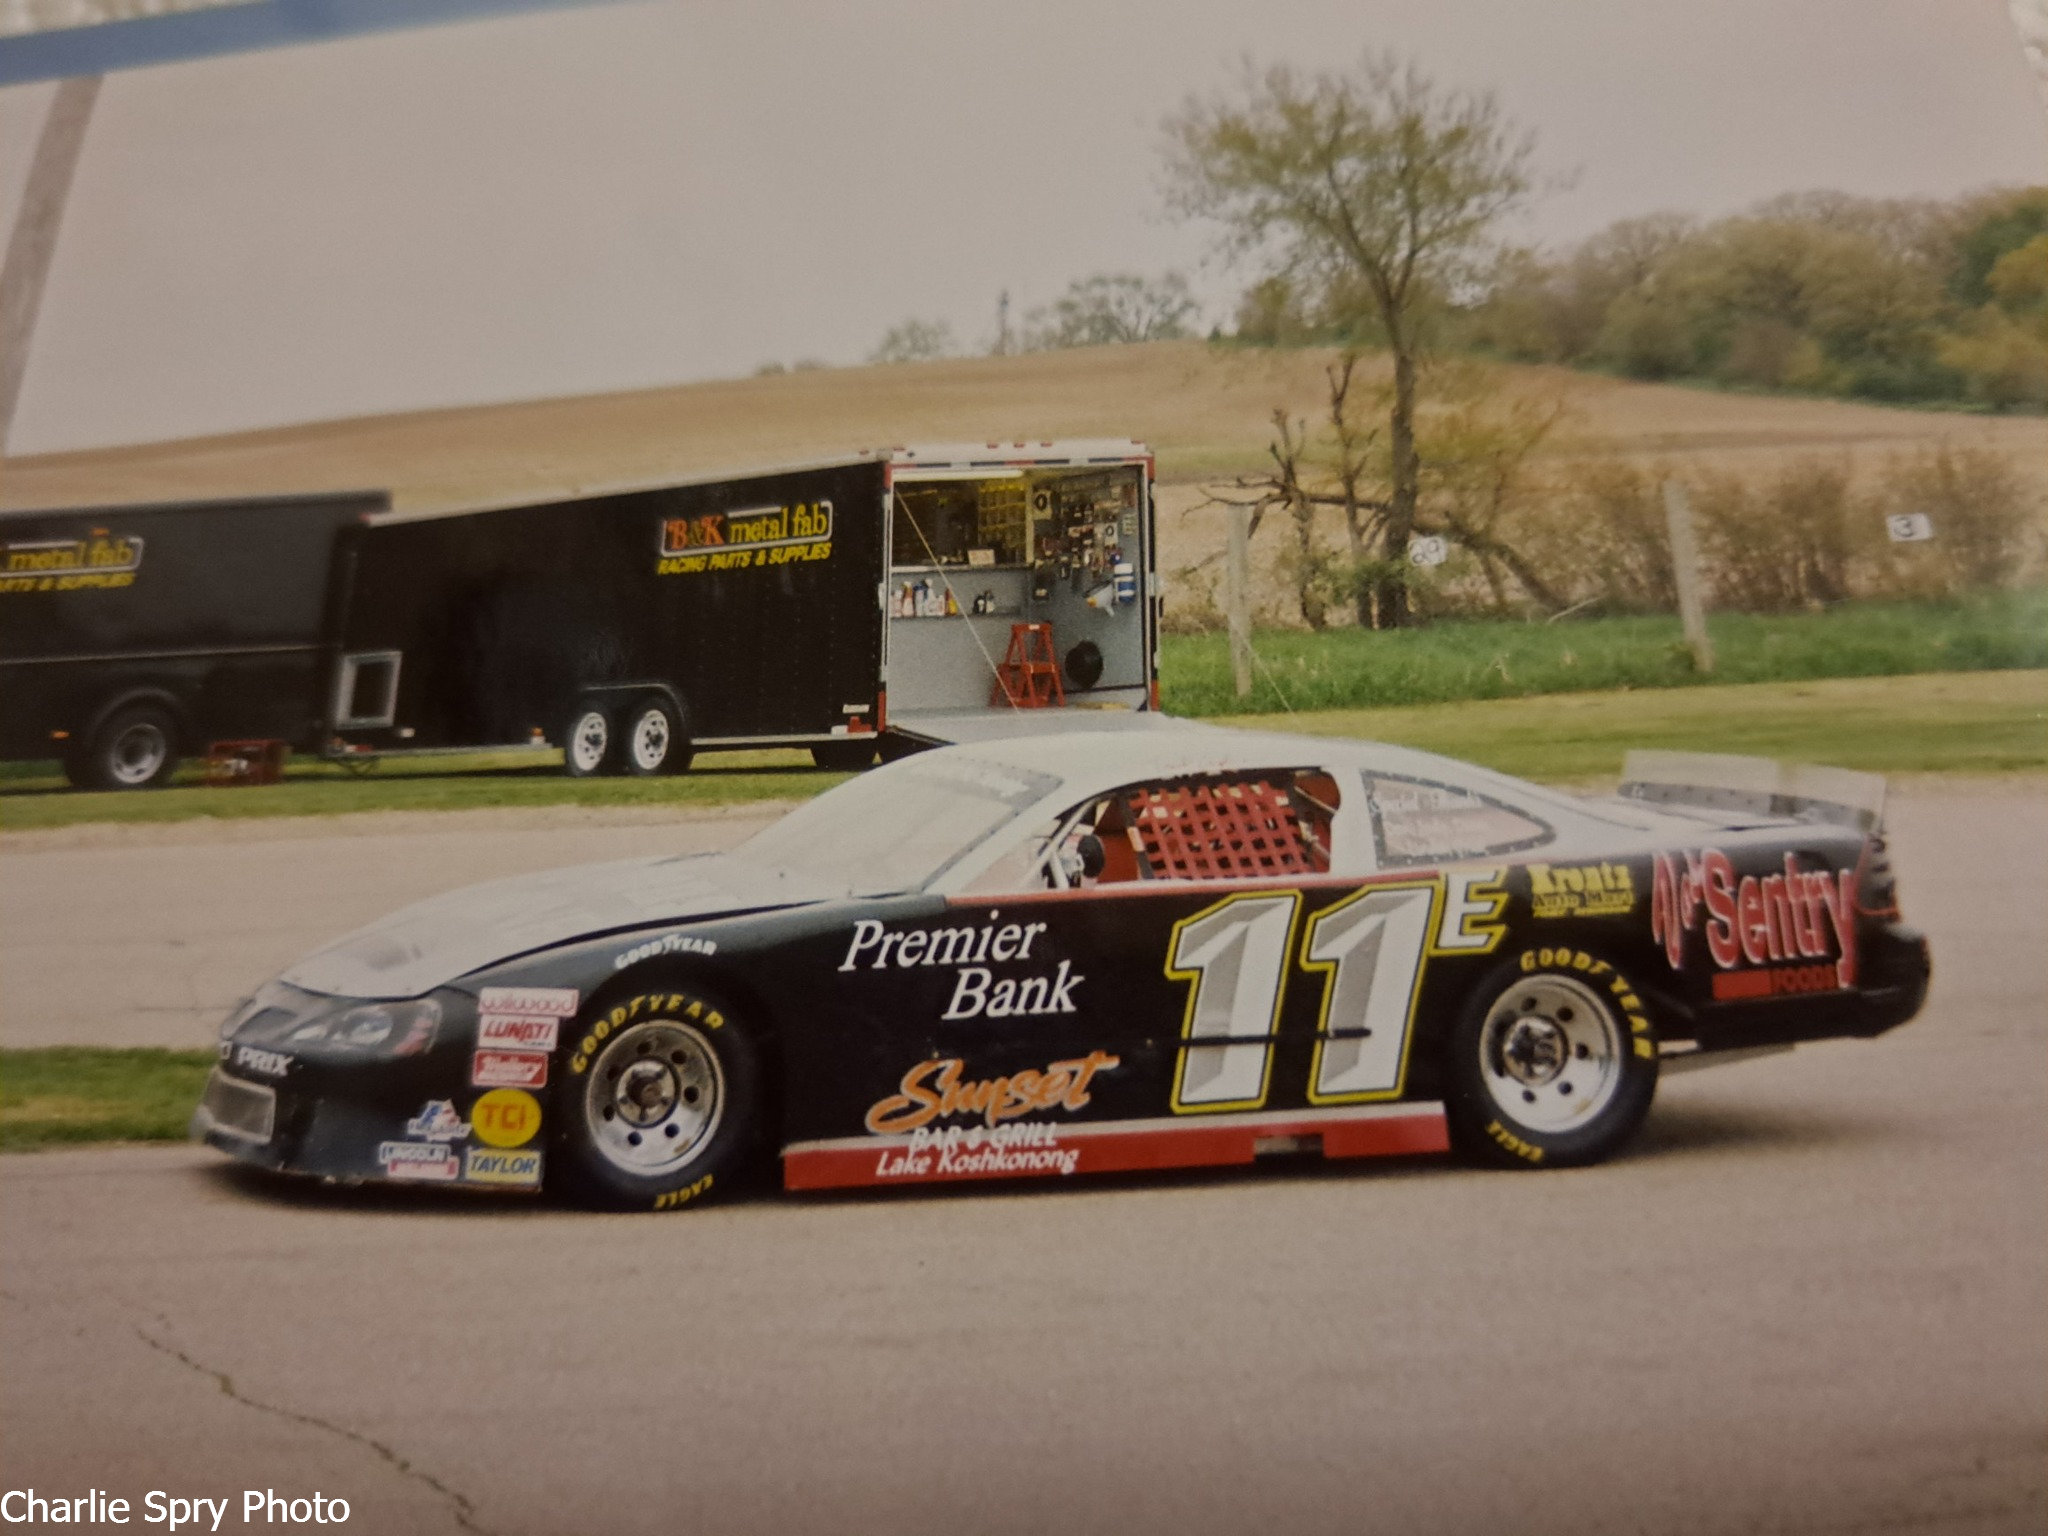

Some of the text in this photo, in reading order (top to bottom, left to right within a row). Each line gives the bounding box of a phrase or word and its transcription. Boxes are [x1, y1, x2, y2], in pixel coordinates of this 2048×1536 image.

[667, 503, 828, 550] B&K metal fab
[1893, 516, 1914, 538] 3
[9, 539, 134, 570] metal fab
[657, 542, 832, 575] RACING PARTS & SUPPLIES
[0, 577, 38, 592] ARTS
[57, 573, 135, 590] SUPPLIES
[1701, 848, 1856, 988] Sentry
[614, 934, 717, 969] GOODYEAR
[838, 909, 1047, 971] Premier
[941, 959, 1085, 1020] Bank
[1520, 948, 1653, 1059] GOODYEAR
[571, 993, 724, 1074] GOODYEAR
[237, 1046, 295, 1077] PRIX
[865, 1051, 1120, 1135] Sunset
[481, 1103, 528, 1131] TCI
[910, 1125, 962, 1152] BAR
[989, 1121, 1058, 1149] GRILL
[471, 1156, 536, 1174] TAYLOR
[876, 1147, 1079, 1176] Lake Koshkonong
